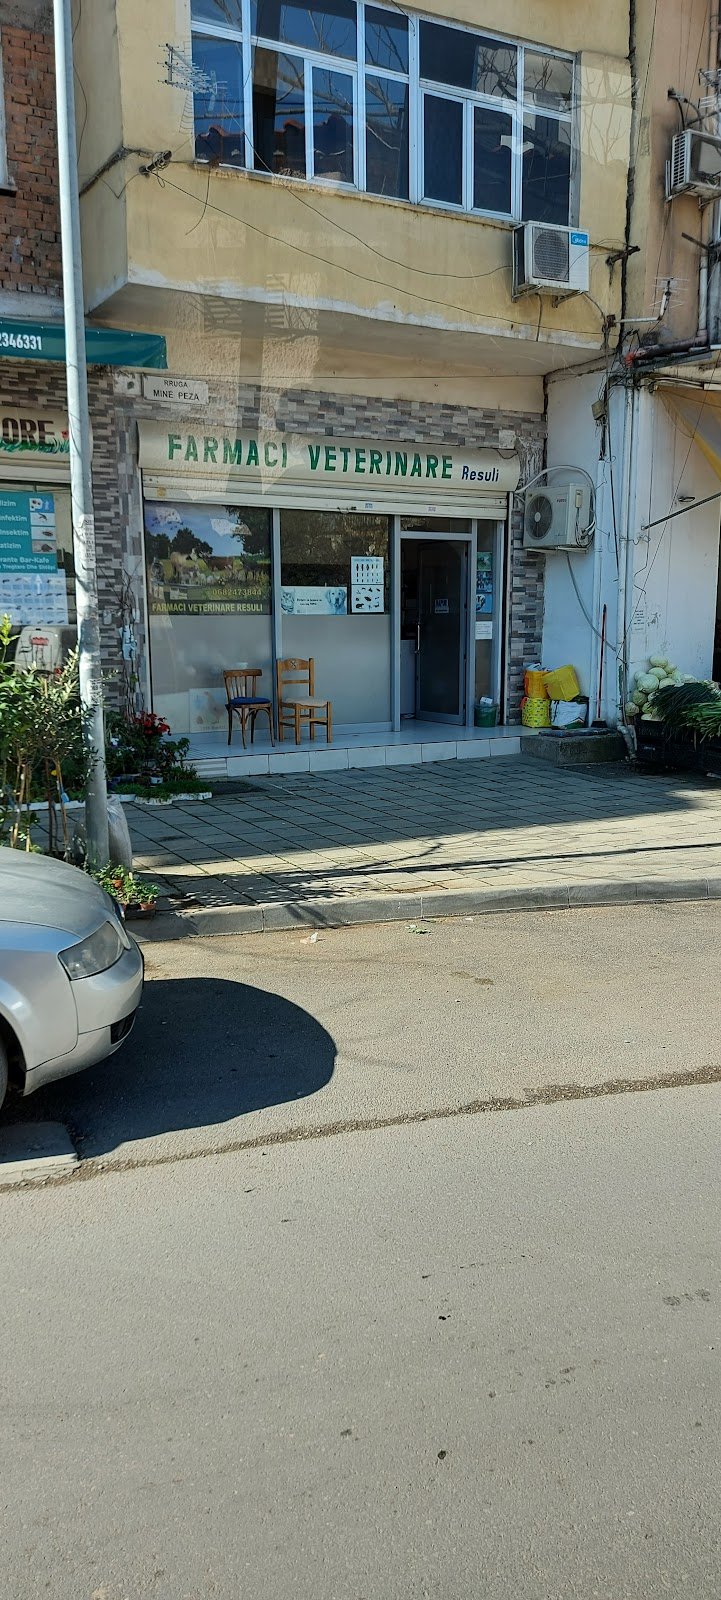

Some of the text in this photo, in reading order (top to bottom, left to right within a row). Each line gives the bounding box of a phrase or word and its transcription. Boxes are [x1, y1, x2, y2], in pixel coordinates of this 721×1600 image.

[164, 379, 188, 388] RRUGA
[153, 390, 200, 402] MINE PEZA
[2, 417, 55, 448] ORE
[167, 433, 500, 483] FARMACI VETERINARE Resuli
[152, 603, 263, 612] FARMACI VETERINARE RESULI
